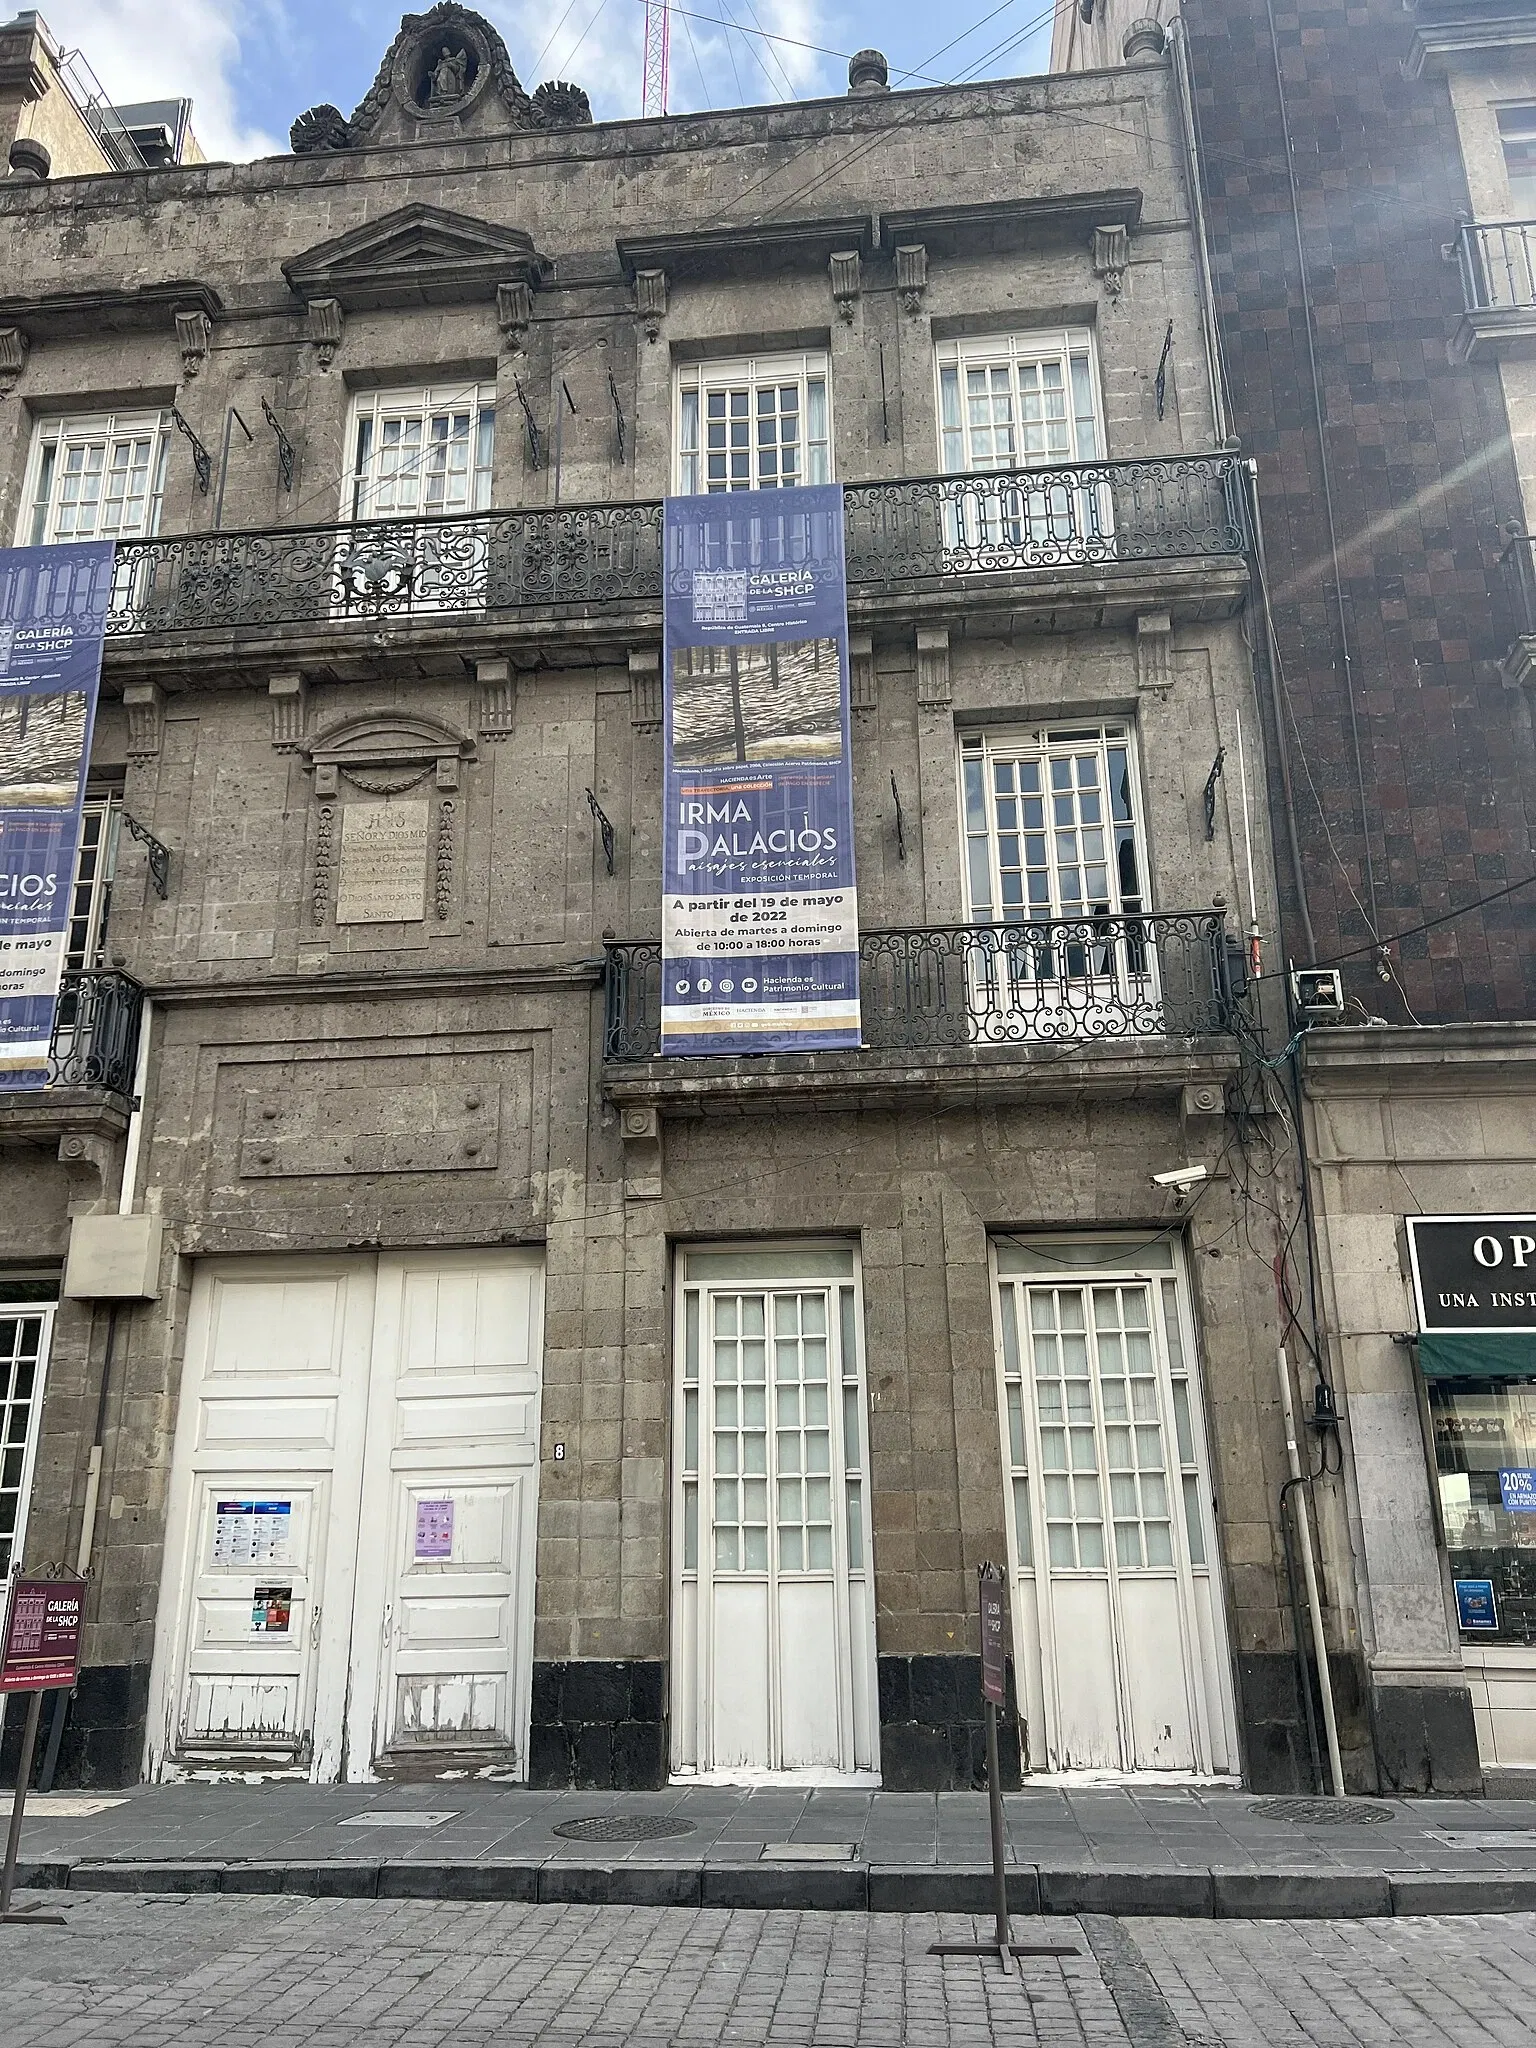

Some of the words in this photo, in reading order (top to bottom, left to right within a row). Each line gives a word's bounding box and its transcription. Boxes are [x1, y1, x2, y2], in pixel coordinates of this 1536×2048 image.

[750, 569, 813, 585] GALERÍA
[774, 583, 815, 597] SHCP
[16, 625, 73, 640] GALERÍA
[36, 639, 73, 651] SHCP
[720, 776, 749, 784] HACIENDA
[757, 773, 773, 781] Arte
[743, 781, 773, 789] COLECCIÓN
[680, 799, 751, 825] IRMA
[389, 830, 409, 840] DIOS
[751, 853, 838, 870] esenciales
[740, 874, 791, 883] EXPOSICIÓN
[792, 872, 838, 881] TEMPORAL
[673, 899, 684, 909] A
[688, 898, 730, 912] partir
[734, 897, 757, 909] del
[761, 897, 776, 908] 19
[780, 896, 799, 907] de
[803, 894, 844, 909] mayo
[363, 908, 394, 919] SANTO
[730, 912, 749, 923] de
[752, 911, 787, 922] 2022
[10, 916, 52, 925] TEMPORAL
[675, 928, 717, 938] Abierta
[720, 927, 735, 937] de
[738, 926, 778, 936] martes
[791, 923, 842, 937] domingo
[15, 939, 52, 951] mayo
[697, 942, 711, 951] de
[714, 941, 743, 951] 10:00
[756, 939, 785, 949] 18:00
[788, 938, 821, 948] horas
[763, 976, 802, 985] Hacienda
[0, 983, 25, 991] oras
[763, 983, 809, 993] Patrimonio
[811, 982, 845, 992] Cultural
[7, 1024, 40, 1033] Cultural
[1473, 1235, 1536, 1267] OP
[1438, 1292, 1480, 1307] UNA
[555, 1445, 564, 1459] 8
[48, 1598, 79, 1611] GALERÍA
[58, 1615, 79, 1627] SHCP
